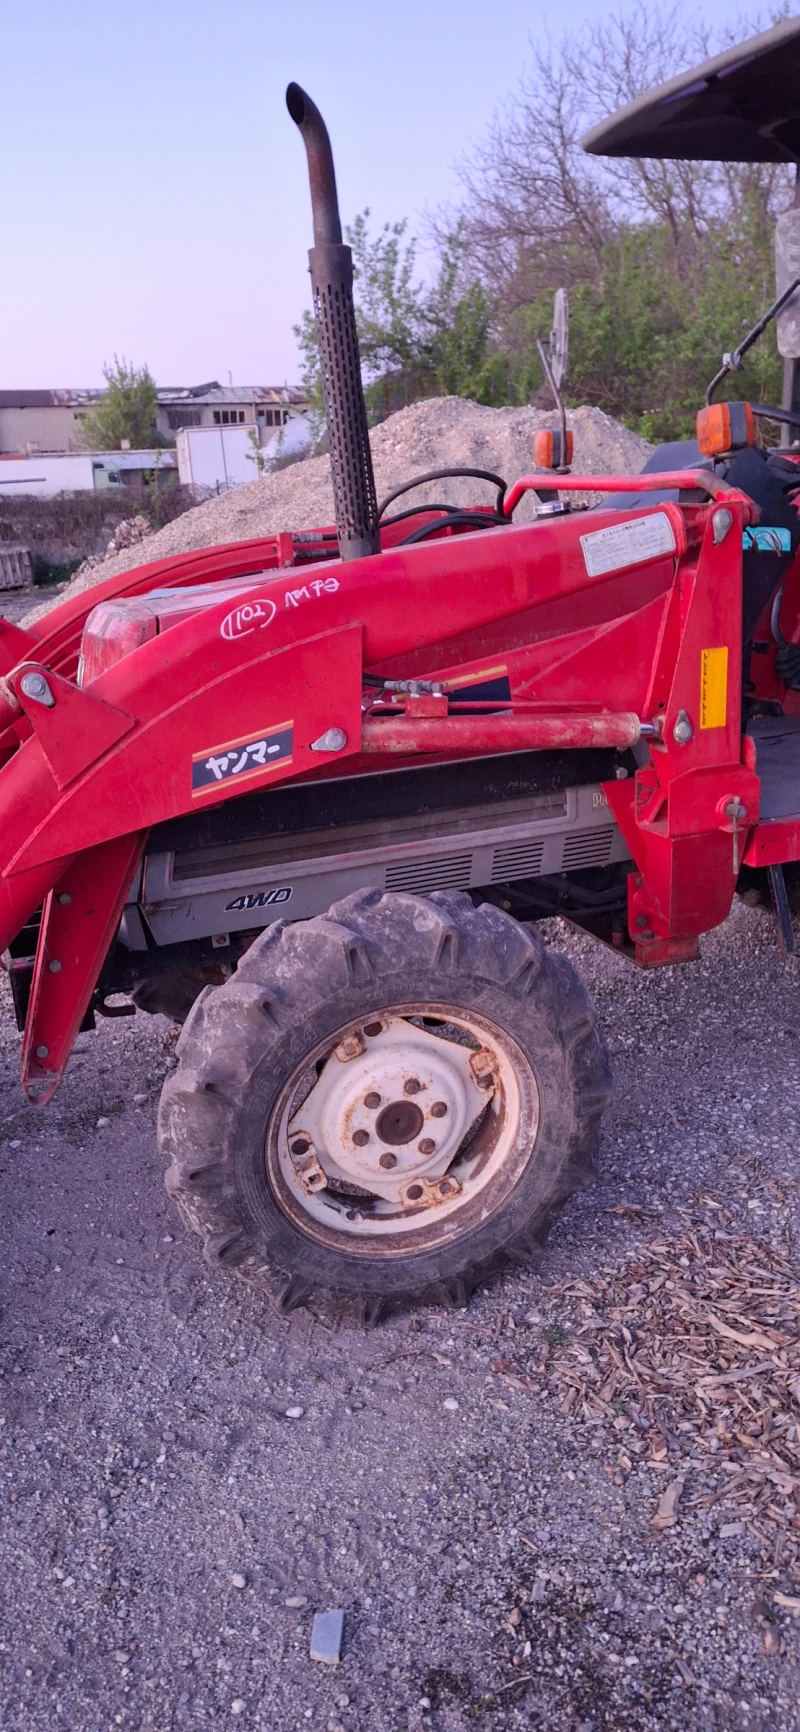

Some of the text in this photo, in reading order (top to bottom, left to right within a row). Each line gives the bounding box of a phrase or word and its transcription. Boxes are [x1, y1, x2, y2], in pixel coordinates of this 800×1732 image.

[228, 604, 266, 638] 1102
[205, 740, 281, 780] ヤンマー
[224, 886, 293, 912] 4WD
